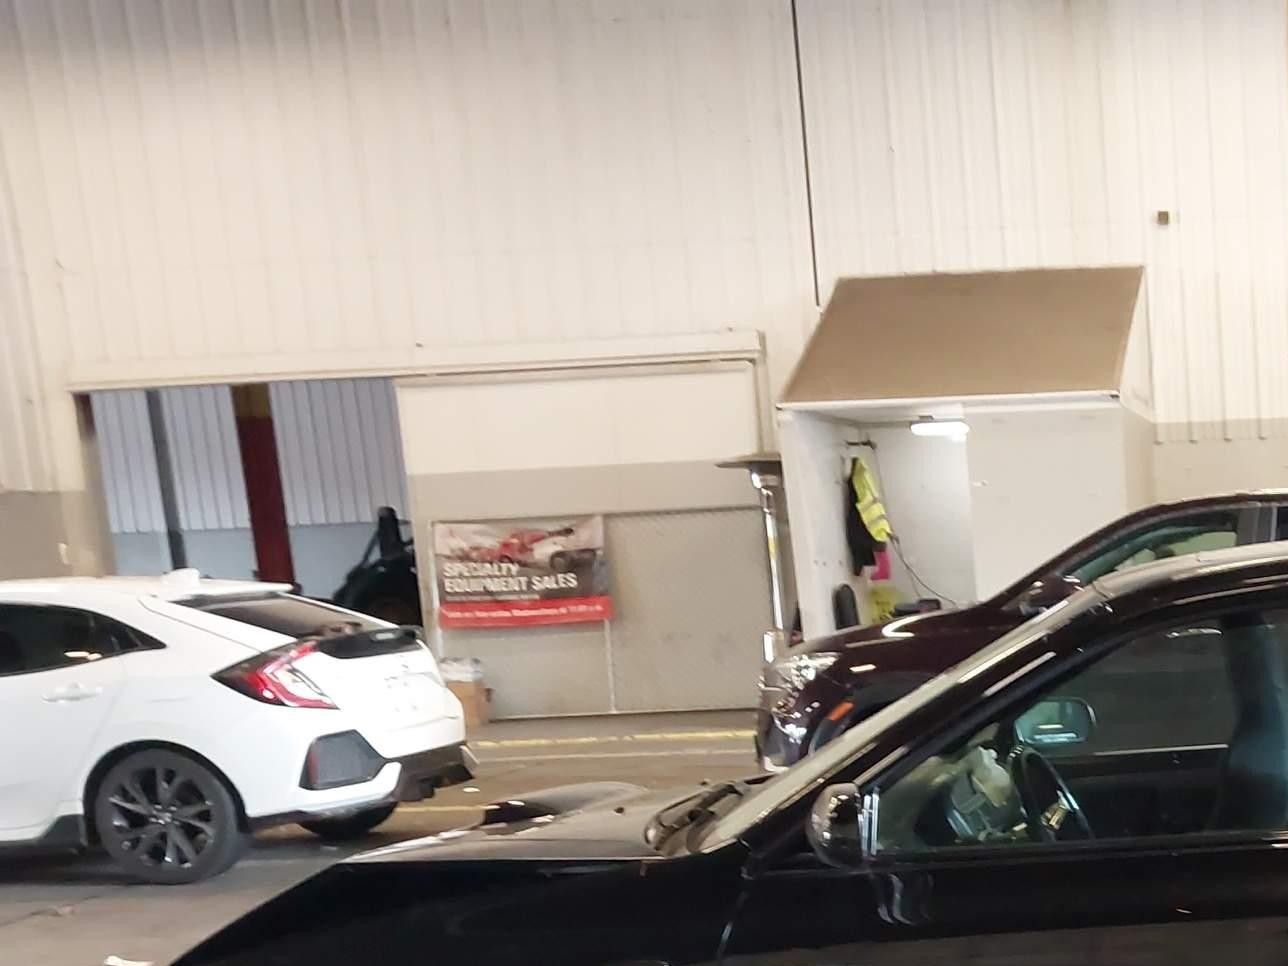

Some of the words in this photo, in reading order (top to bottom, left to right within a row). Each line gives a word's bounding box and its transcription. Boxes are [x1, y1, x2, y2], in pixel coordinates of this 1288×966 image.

[443, 562, 520, 577] SPECIALTY
[443, 576, 529, 593] EQUIPMENT
[530, 572, 578, 591] SALES
